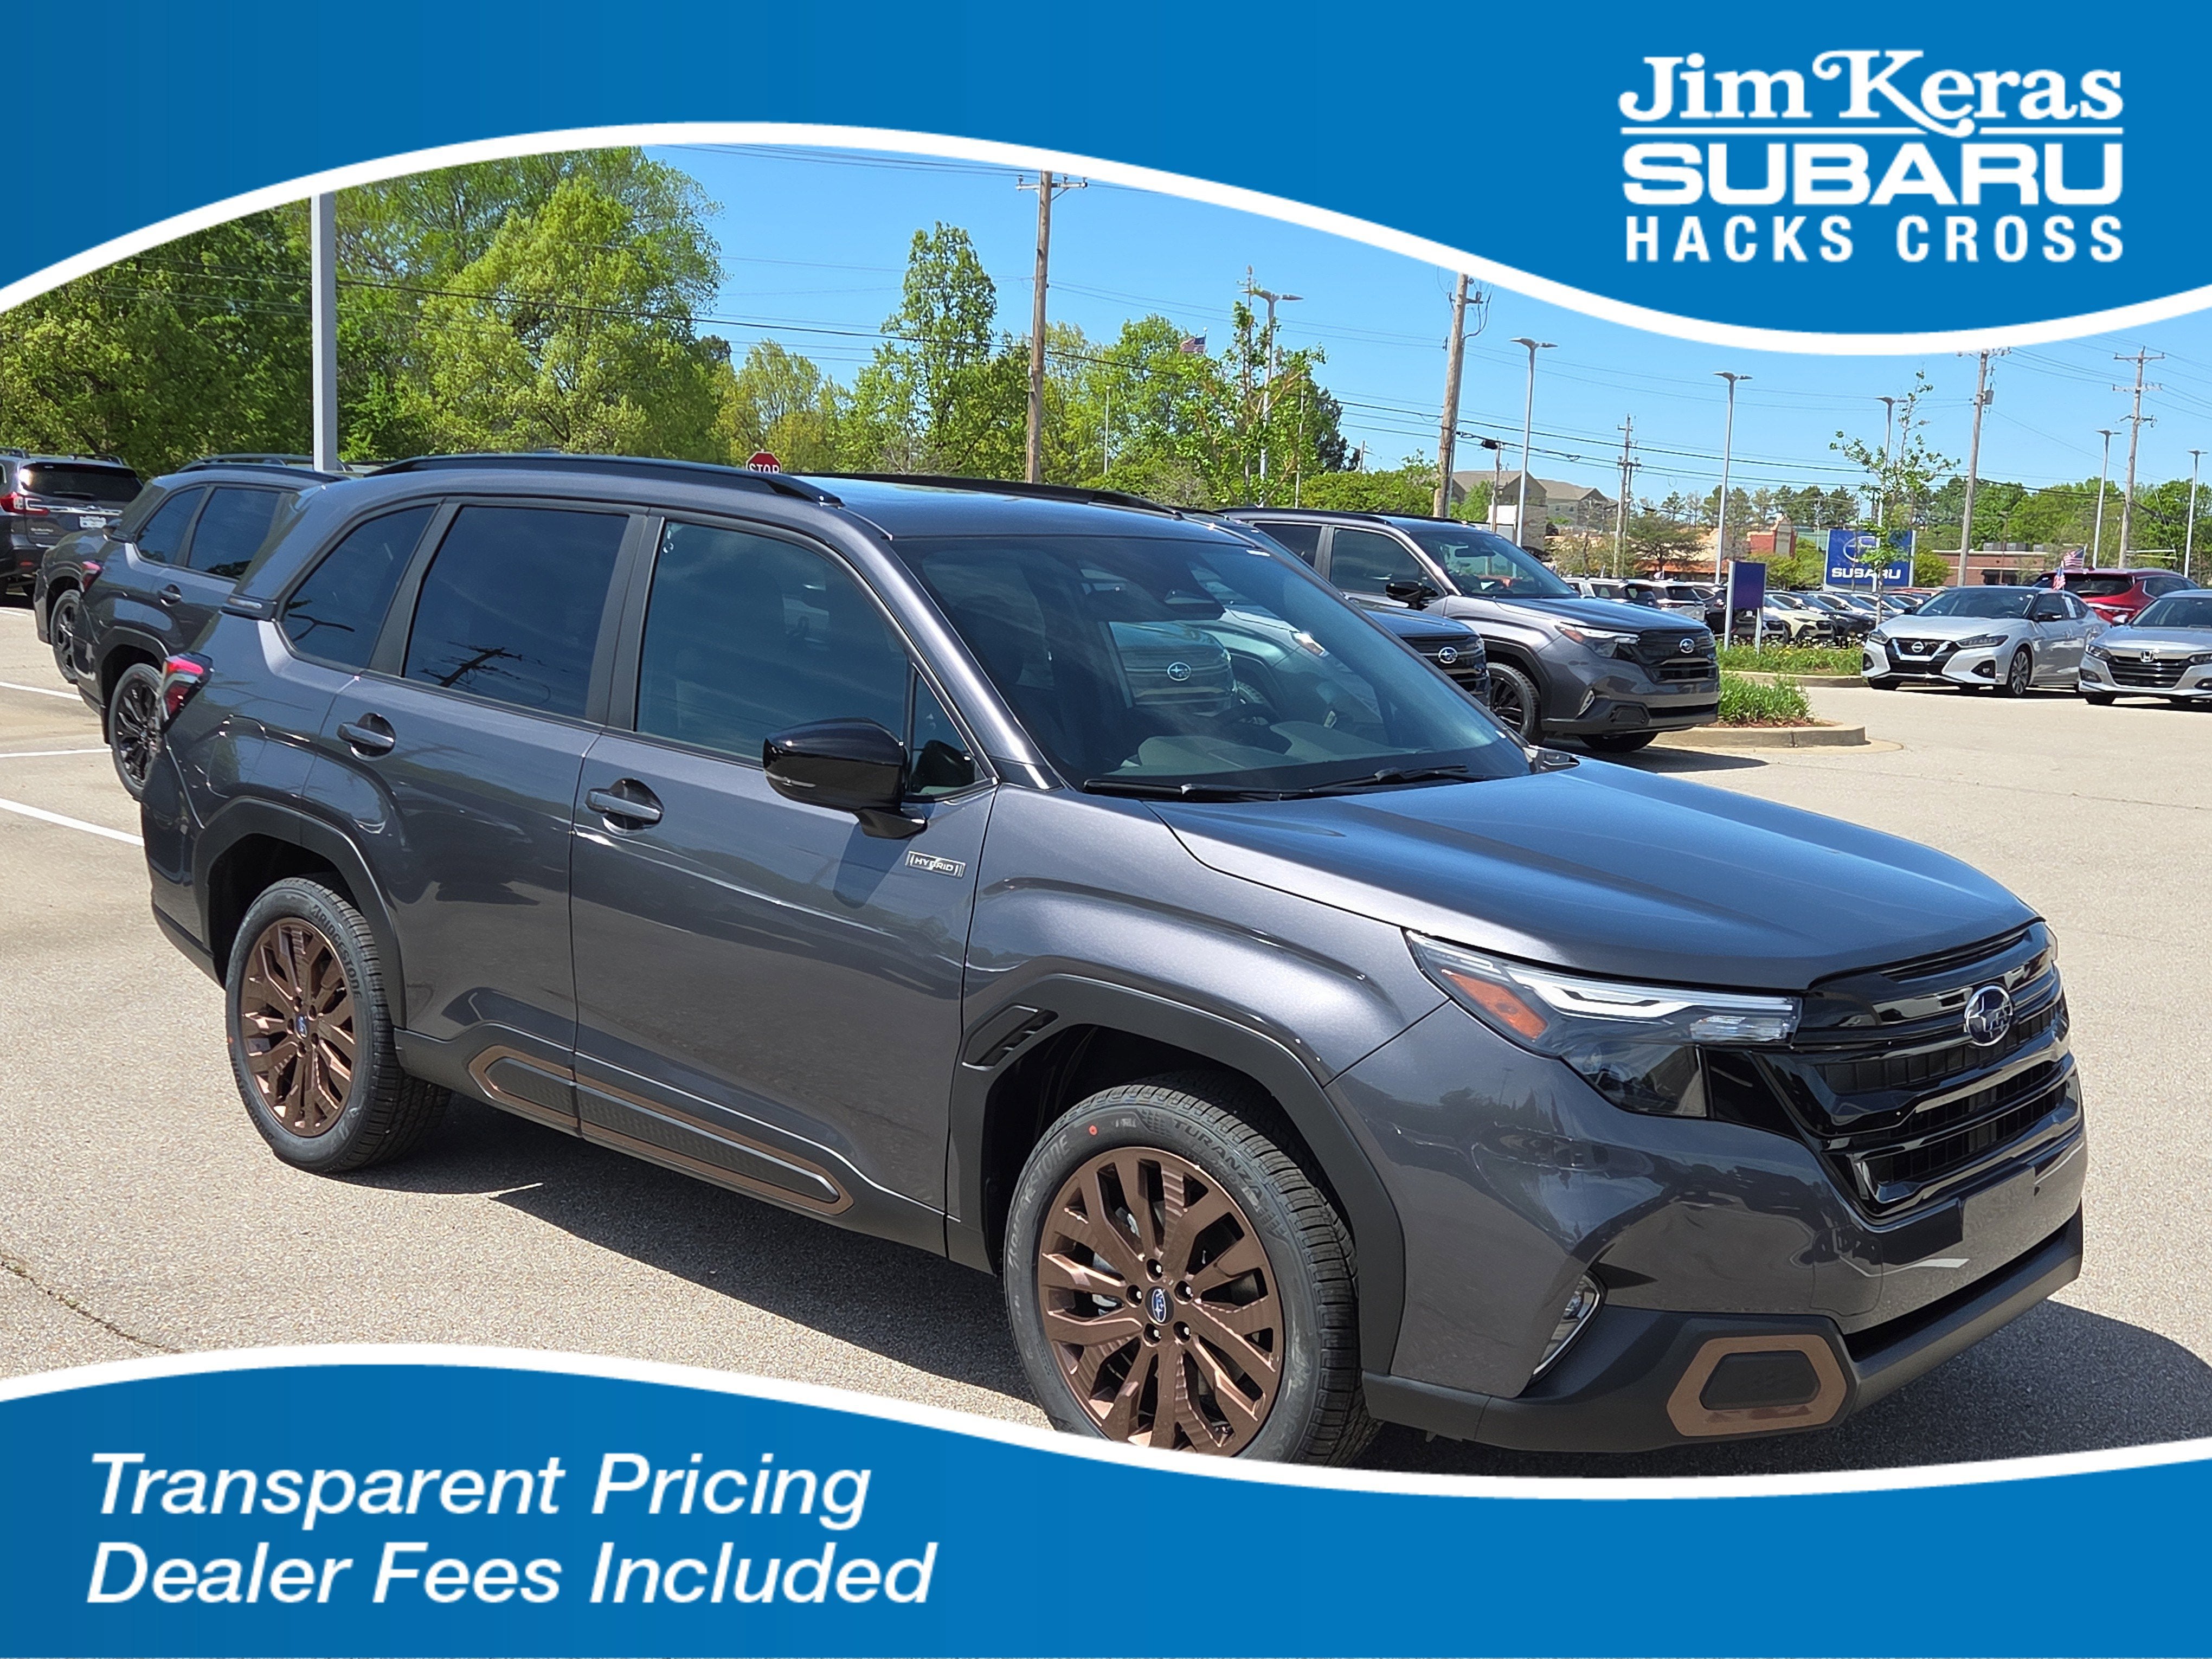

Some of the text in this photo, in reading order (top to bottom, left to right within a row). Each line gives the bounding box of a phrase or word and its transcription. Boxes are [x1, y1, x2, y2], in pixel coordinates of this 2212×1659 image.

[749, 463, 780, 473] STOP
[1831, 568, 1901, 580] SUBARU
[915, 857, 954, 872] HYBRID
[1173, 1118, 1263, 1200] TURANZA
